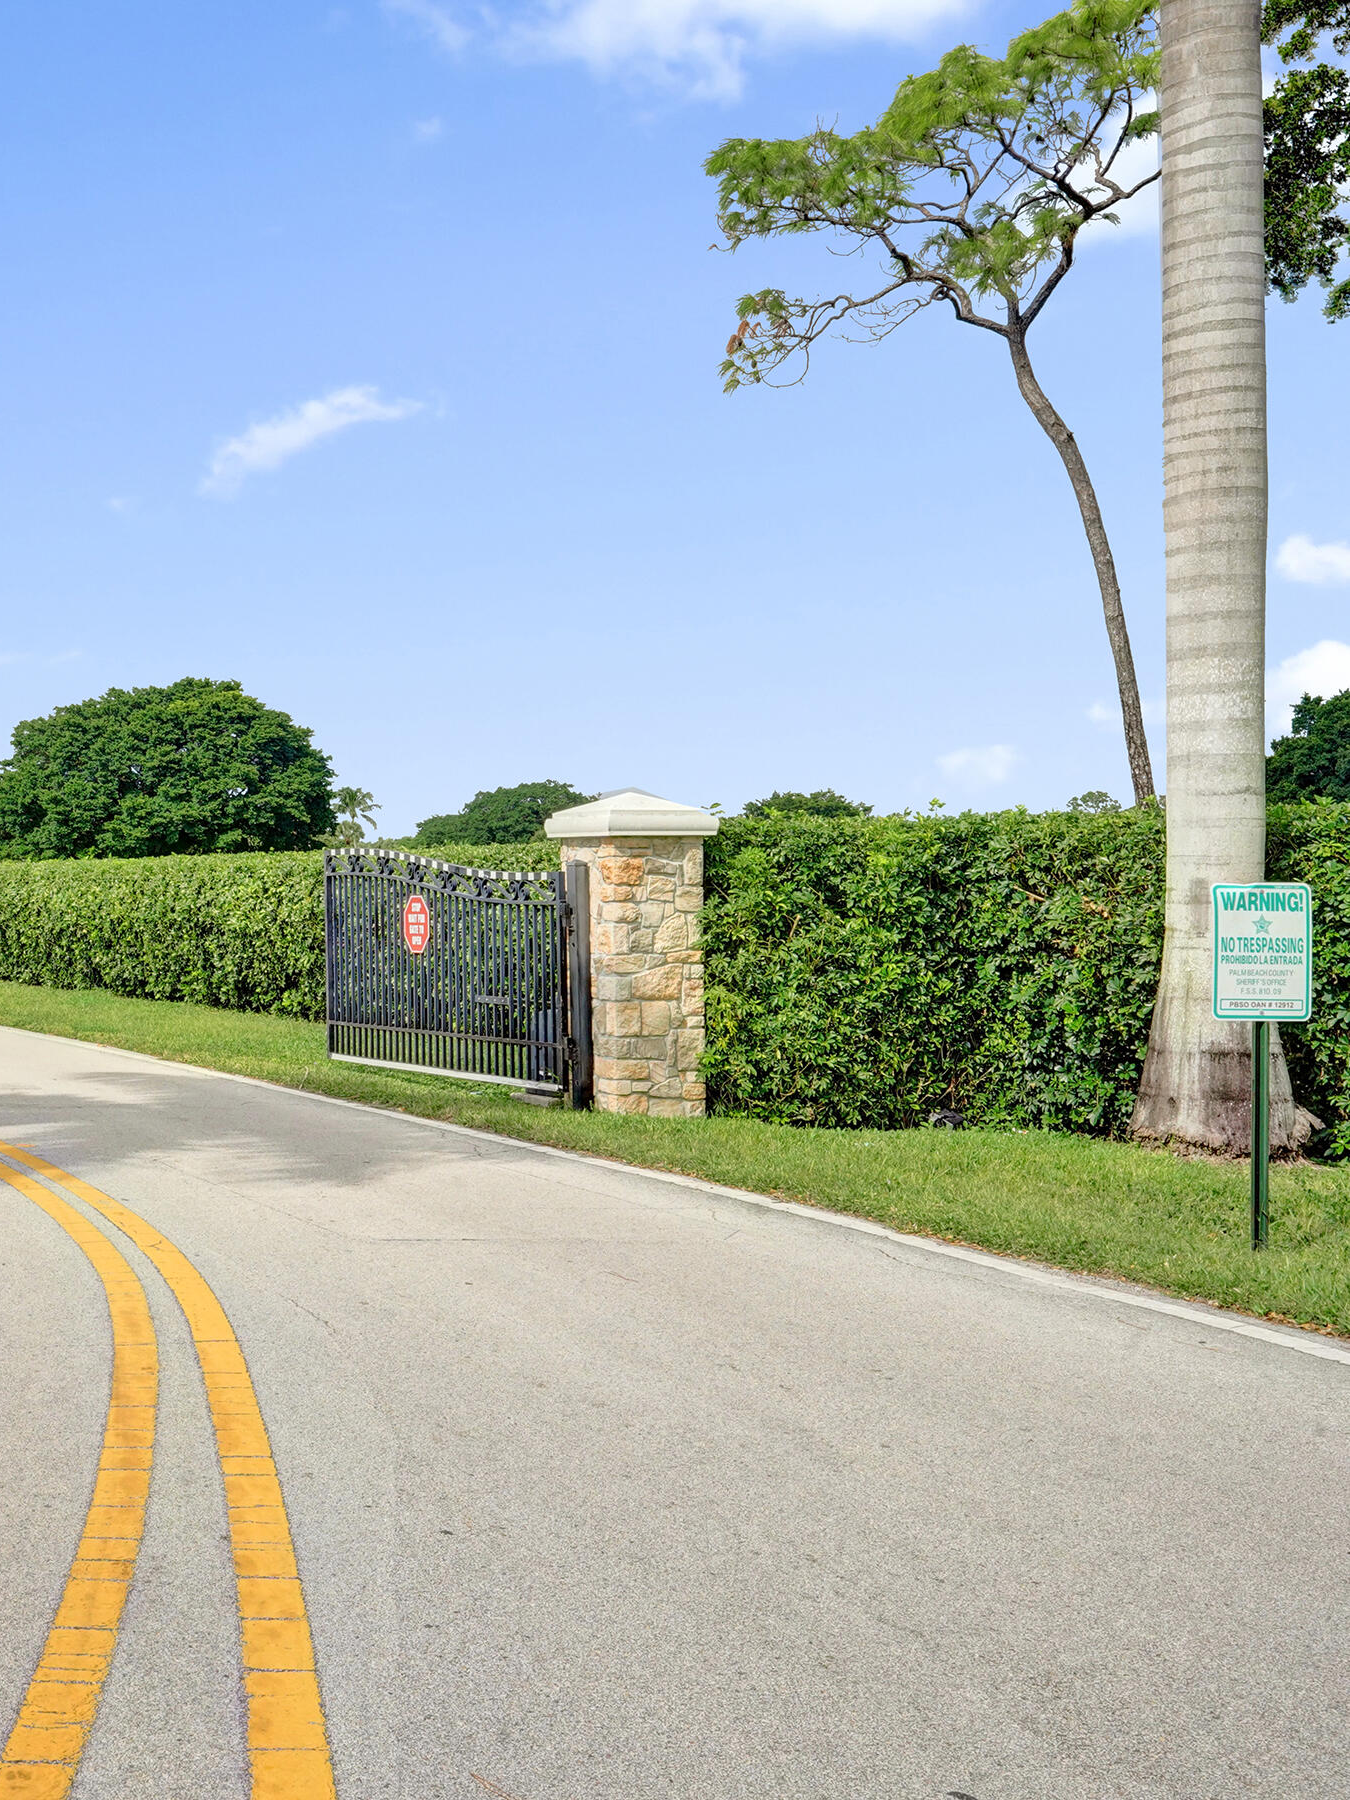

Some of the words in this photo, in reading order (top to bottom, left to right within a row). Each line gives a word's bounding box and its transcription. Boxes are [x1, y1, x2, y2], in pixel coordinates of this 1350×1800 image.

[411, 902, 422, 912] STOP
[1220, 891, 1303, 912] WARNING!
[1221, 936, 1236, 953] NO
[1236, 936, 1304, 954] TRESPASSING
[1220, 954, 1258, 965] PROHIBIDO
[1259, 955, 1268, 965] LA
[1270, 955, 1303, 965] ENTRADA
